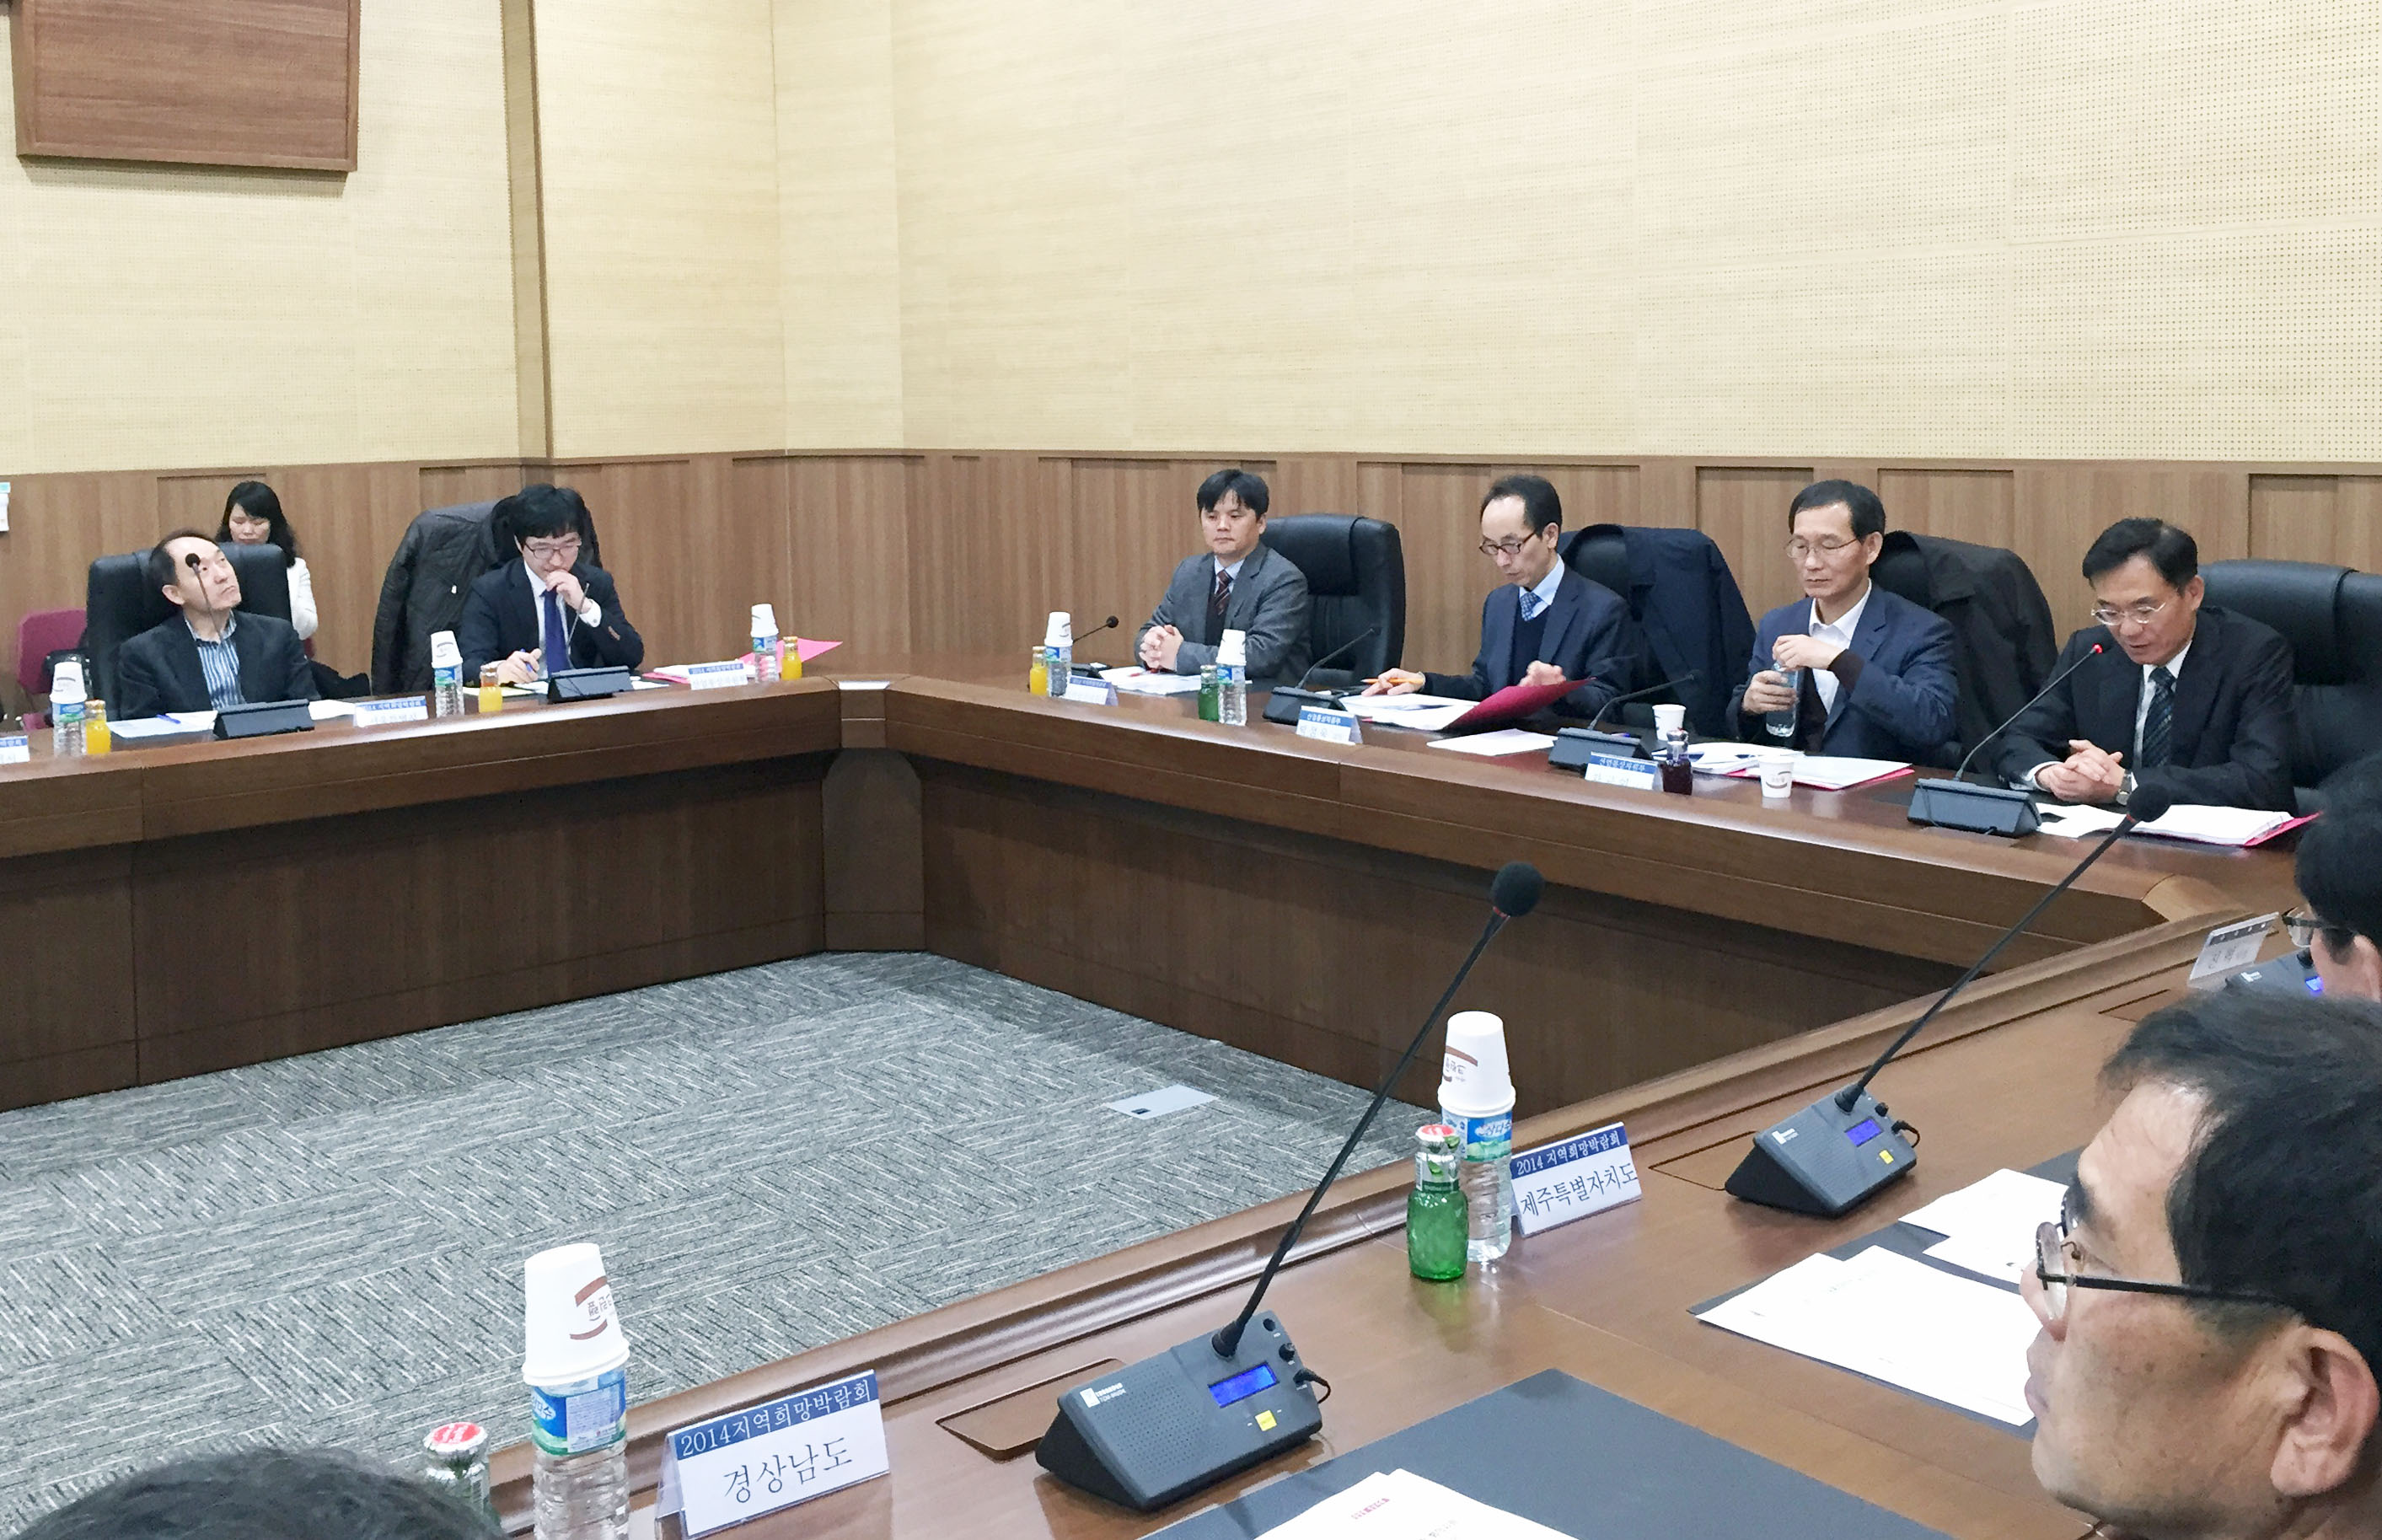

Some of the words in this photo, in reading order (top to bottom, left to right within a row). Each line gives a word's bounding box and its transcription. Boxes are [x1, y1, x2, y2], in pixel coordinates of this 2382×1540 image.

[1516, 1155, 1544, 1176] 2014
[1546, 1130, 1621, 1165] 지역희망박람회
[1520, 1162, 1639, 1216] 제주특별자치도
[723, 1436, 853, 1504] 경상남도
